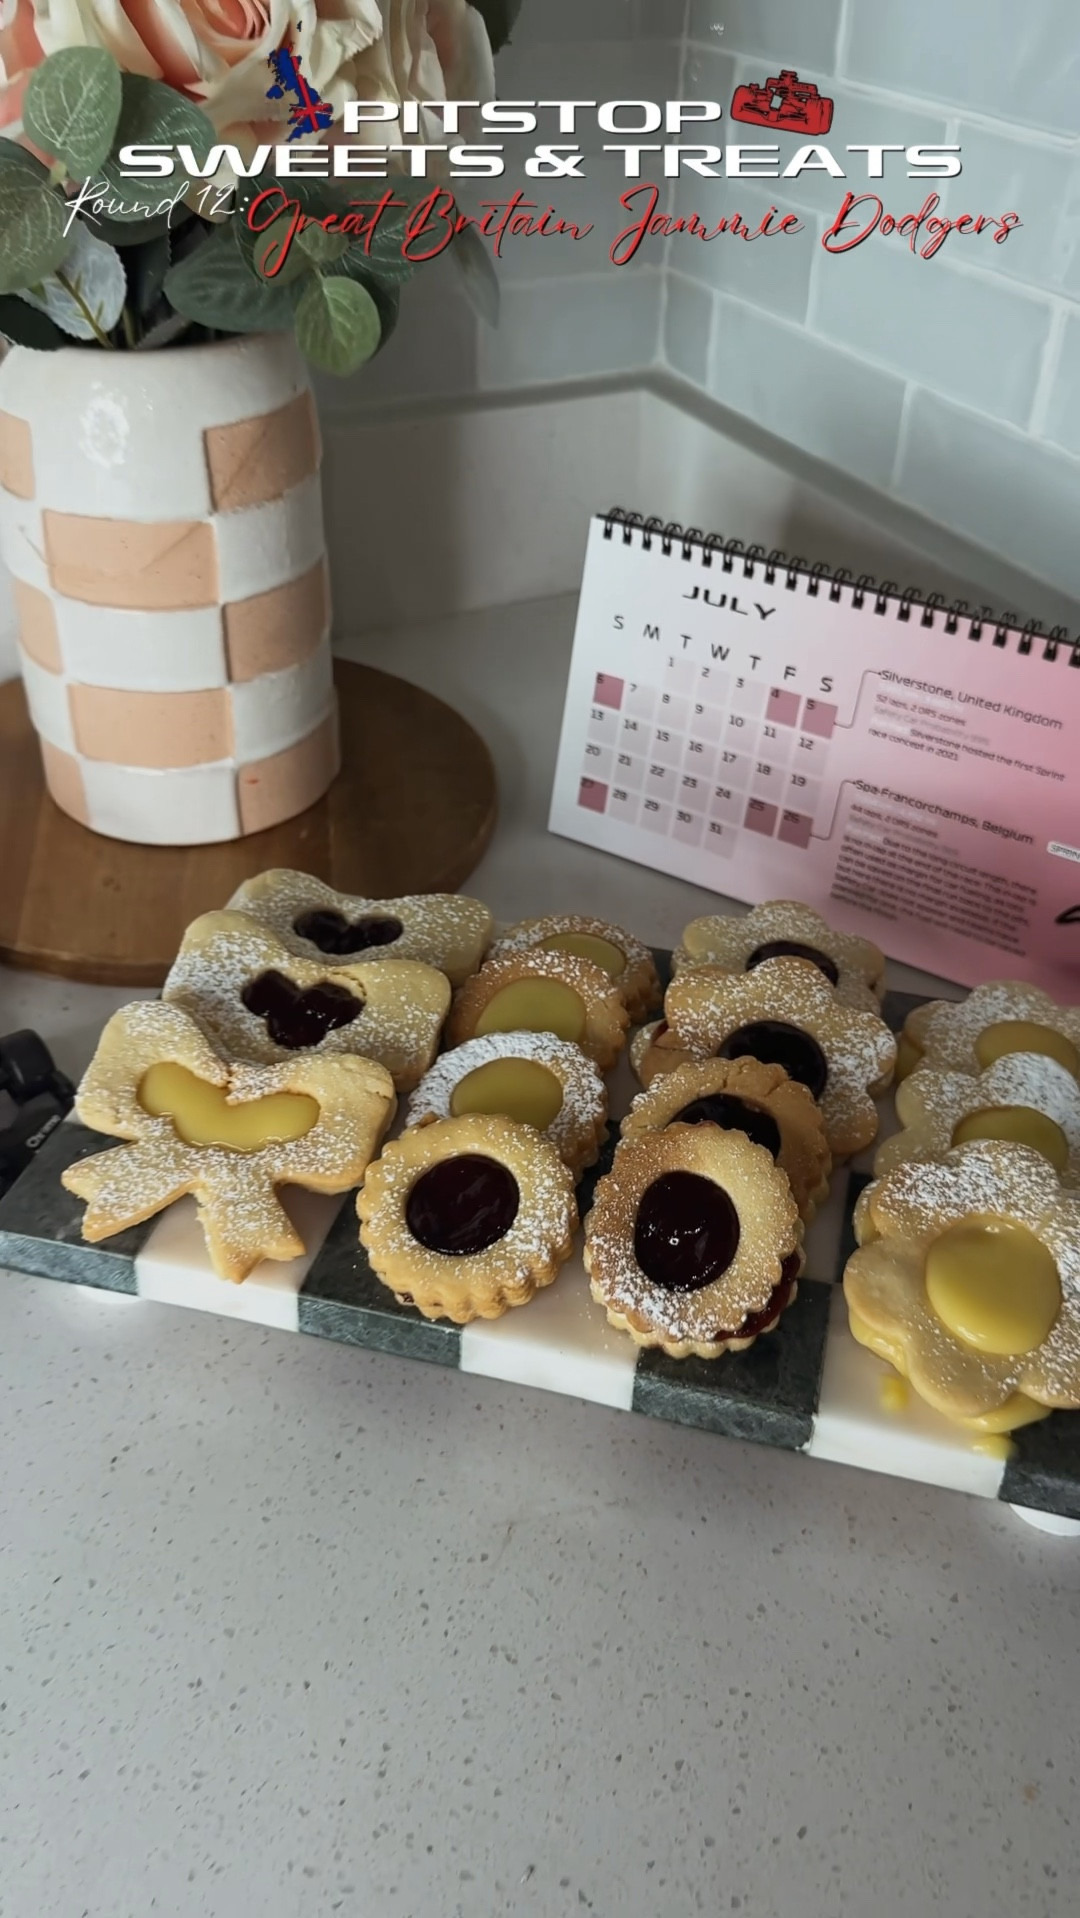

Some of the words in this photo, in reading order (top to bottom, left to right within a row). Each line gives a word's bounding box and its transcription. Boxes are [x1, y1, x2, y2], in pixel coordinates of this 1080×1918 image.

[683, 586, 776, 620] JULY
[613, 615, 624, 630] S
[643, 624, 661, 641] M
[680, 634, 692, 649] T
[711, 643, 730, 661] W
[750, 655, 762, 670] T
[783, 665, 796, 680] F
[820, 676, 834, 693] S
[668, 656, 674, 668] 1
[702, 667, 710, 678] 2
[736, 678, 744, 688] 3
[630, 683, 637, 693] 7
[662, 693, 670, 704] 8
[696, 704, 703, 714] 9
[729, 714, 744, 727] 10
[764, 726, 776, 738] 11
[798, 737, 814, 750] 12
[881, 670, 954, 700] Silverstone,
[957, 691, 1001, 713] United
[1003, 705, 1062, 730] Kingdom
[585, 744, 600, 757] 20
[618, 754, 631, 766] 21
[650, 765, 665, 778] 22
[683, 776, 697, 789] 23
[716, 787, 731, 799] 24
[590, 709, 604, 721] 13
[624, 719, 637, 731] 14
[656, 730, 670, 743] 15
[689, 741, 703, 754] 16
[722, 751, 736, 764] 17
[756, 763, 771, 775] 18
[791, 774, 806, 787] 19
[612, 789, 627, 801] 28
[645, 799, 659, 812] 29
[676, 810, 691, 823] 30
[709, 822, 723, 835] 31
[982, 820, 1033, 844] Belgium
